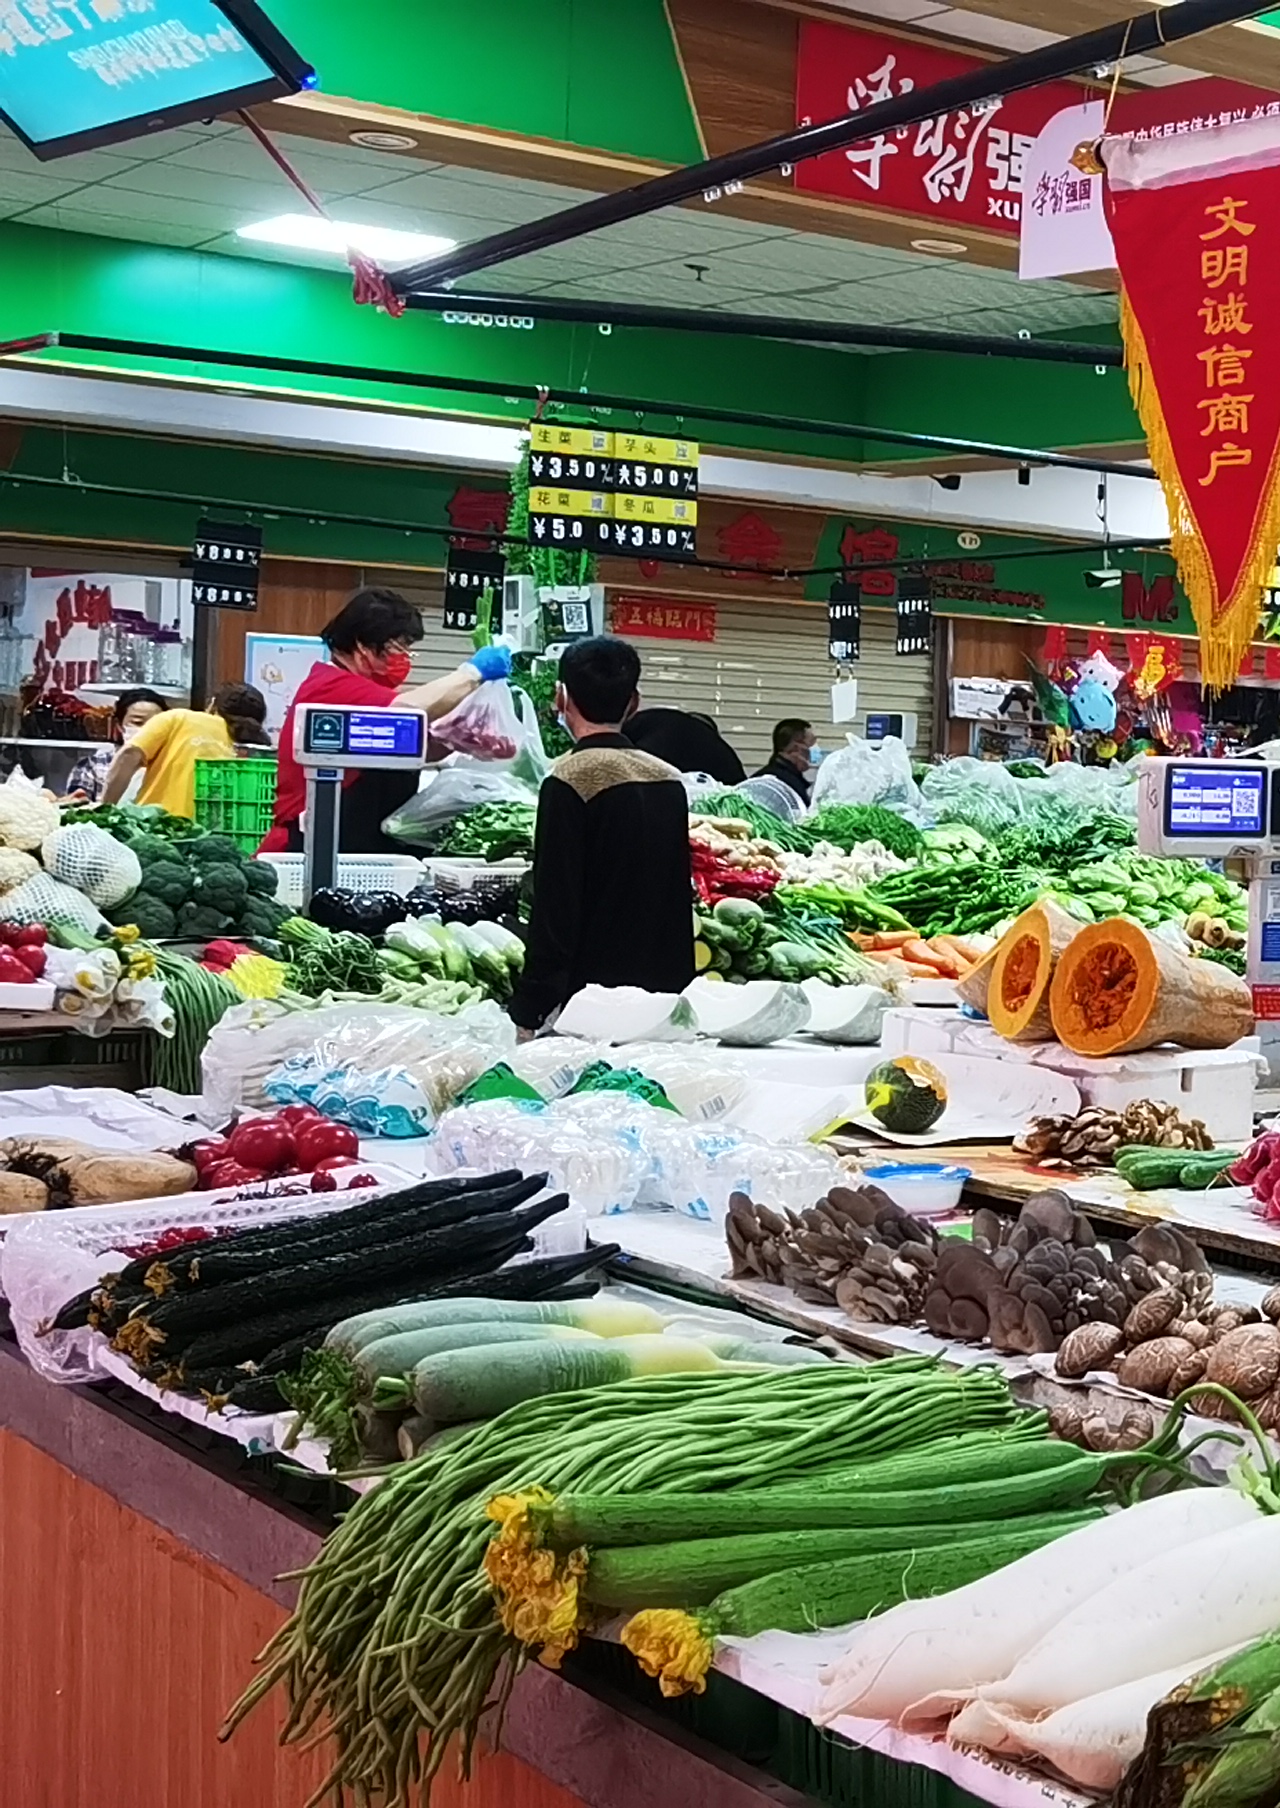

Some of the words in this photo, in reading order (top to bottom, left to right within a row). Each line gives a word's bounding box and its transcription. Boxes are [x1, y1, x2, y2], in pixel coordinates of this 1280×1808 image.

[1031, 170, 1092, 217] 学习强国
[1196, 196, 1257, 487] 文明诚信商户
